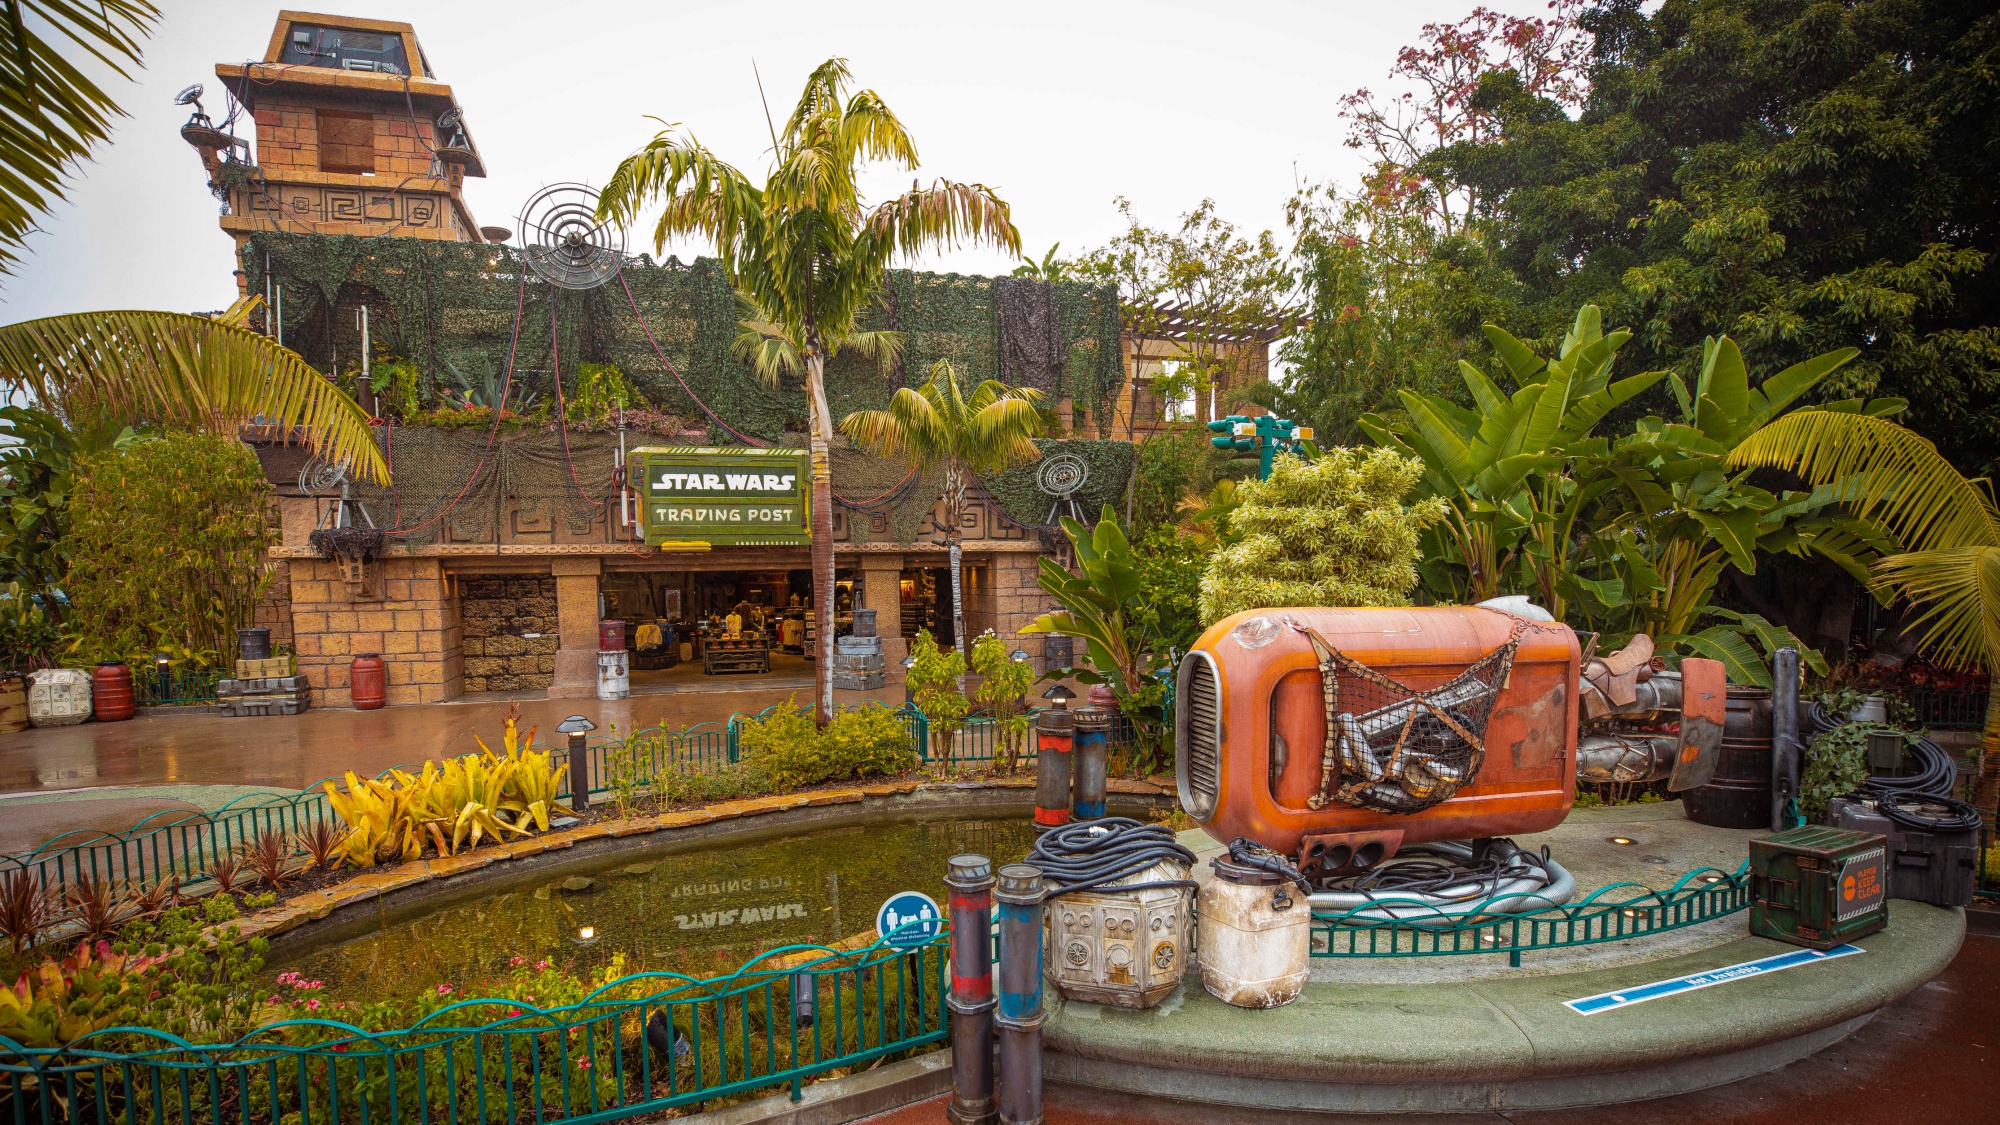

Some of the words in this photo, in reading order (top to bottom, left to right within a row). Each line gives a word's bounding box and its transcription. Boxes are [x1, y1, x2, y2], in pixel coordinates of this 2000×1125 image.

[652, 474, 725, 490] STAR
[725, 474, 796, 491] WARS
[656, 508, 741, 522] TRADING
[748, 509, 793, 522] POST
[1858, 866, 1876, 878] PLEASE
[1858, 875, 1876, 889] KEEP
[1858, 883, 1881, 900] CLEAR
